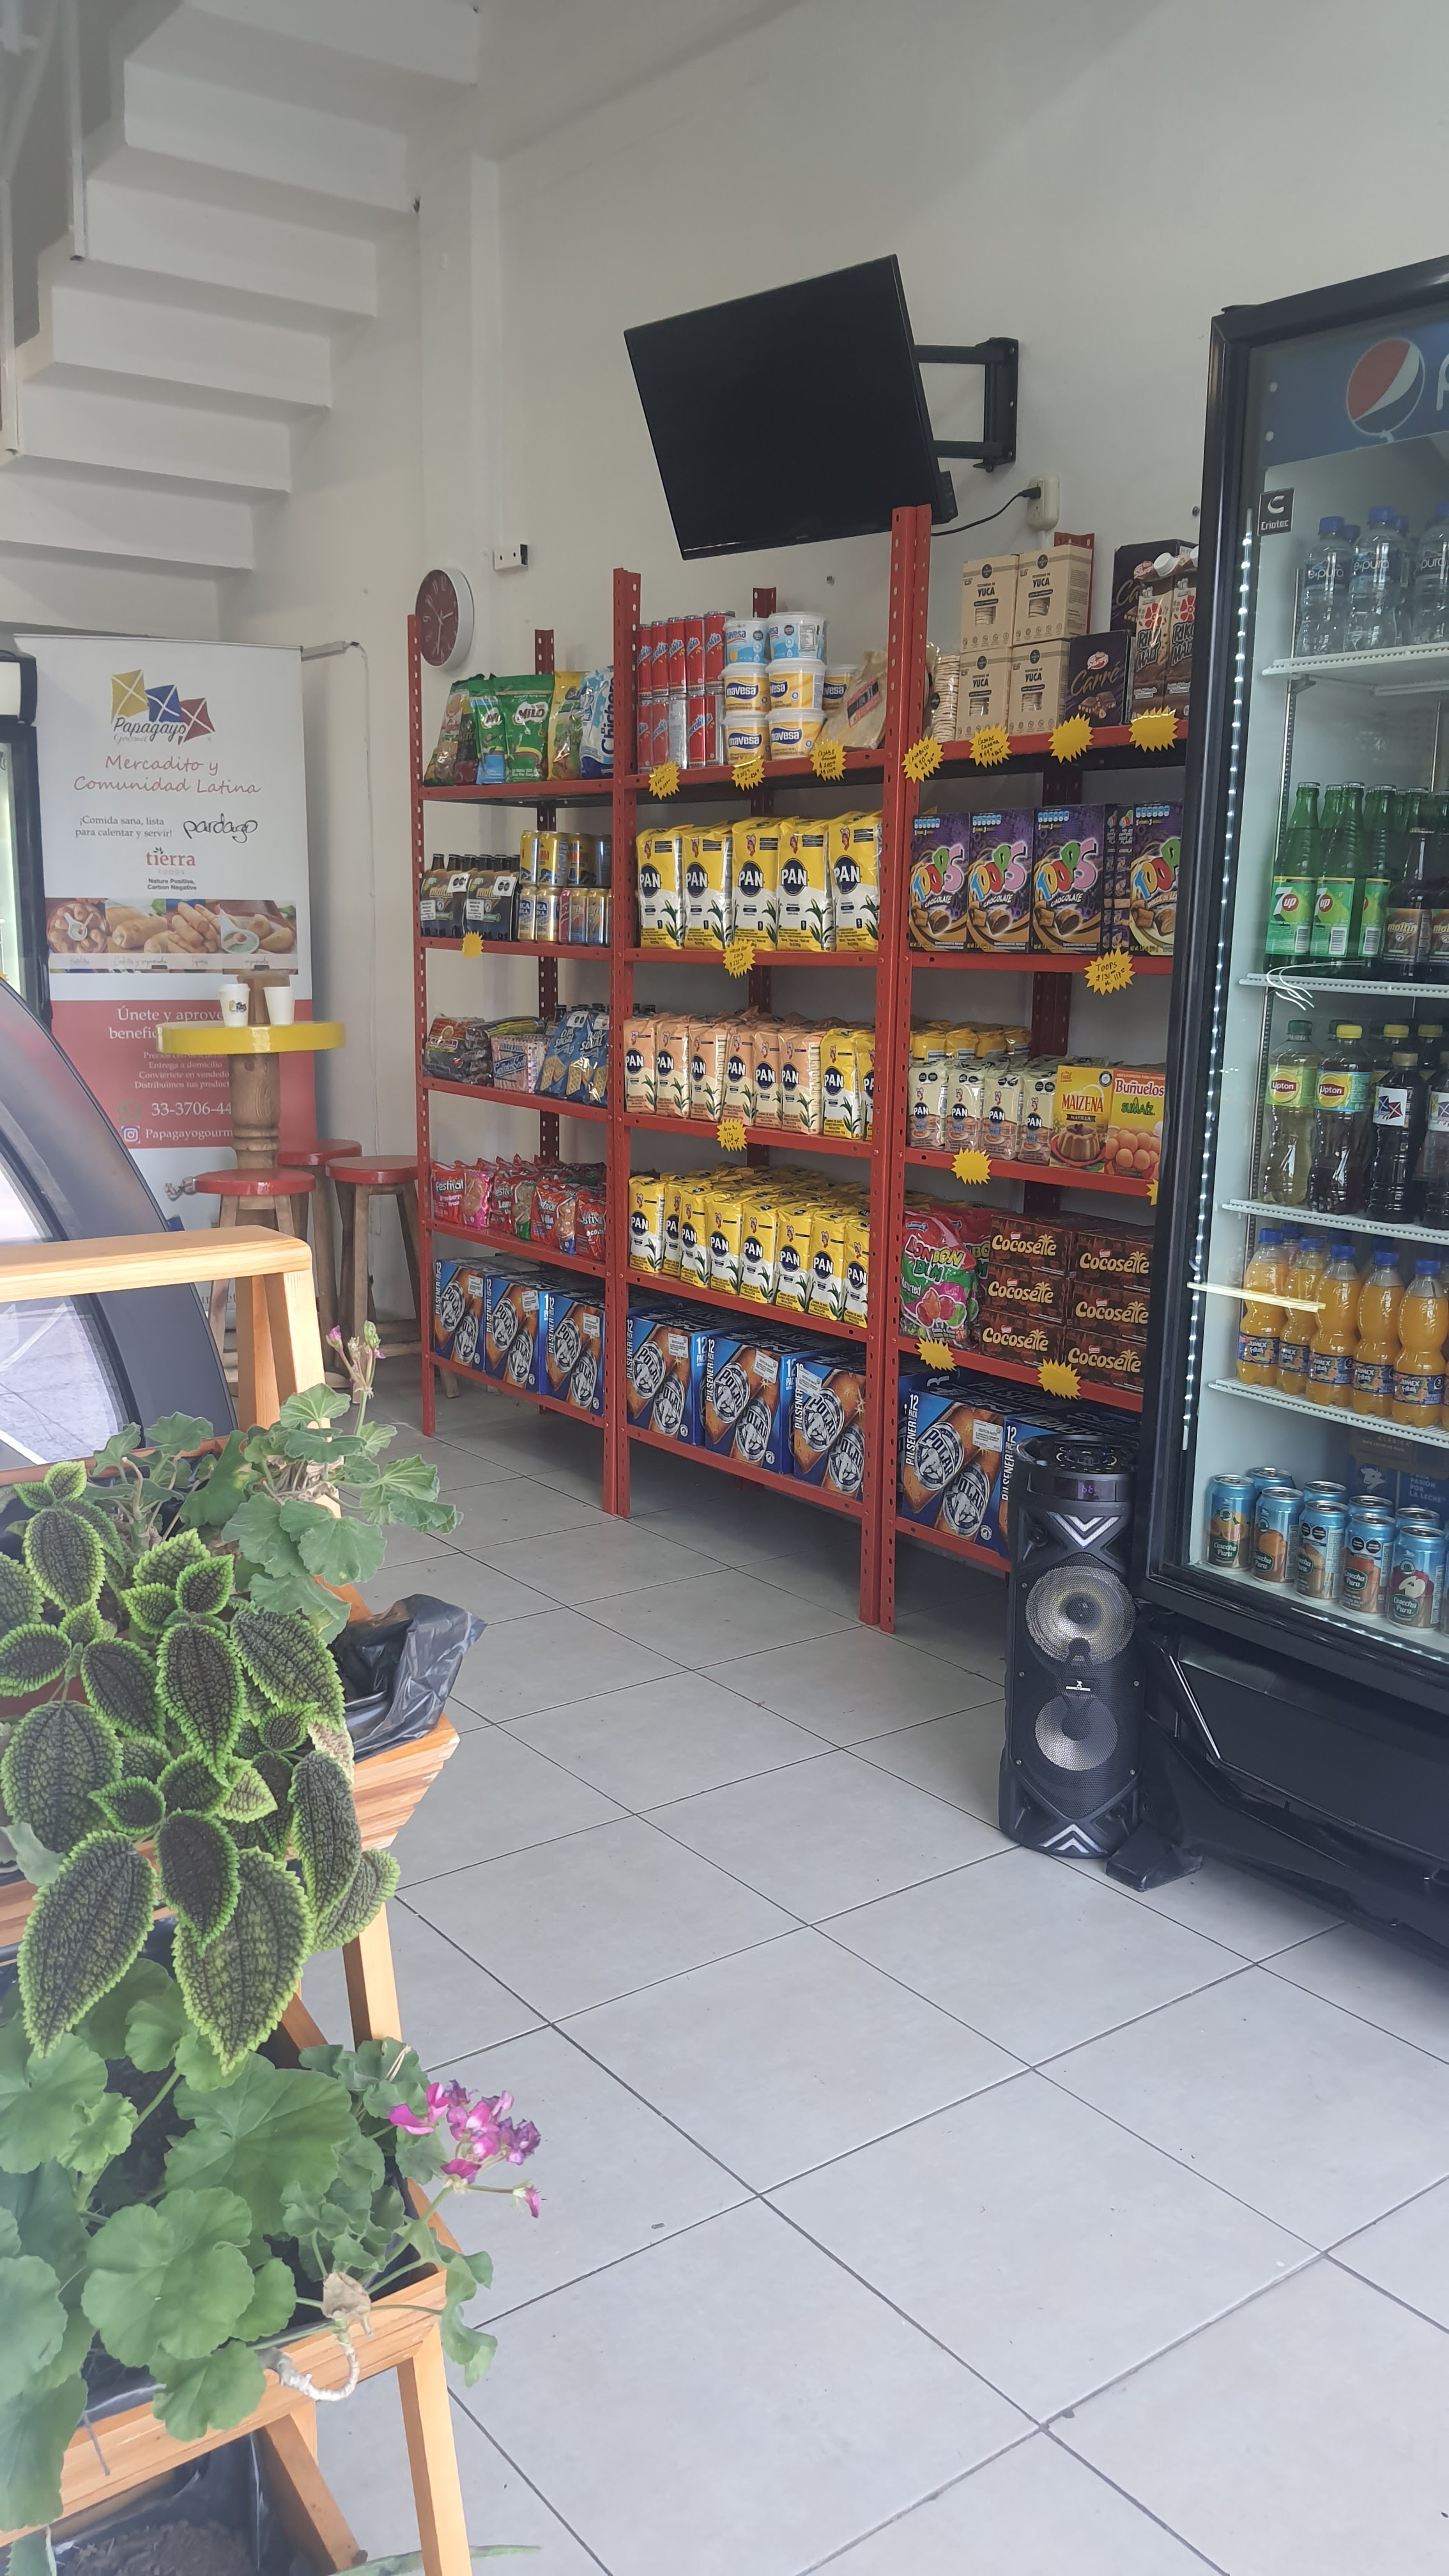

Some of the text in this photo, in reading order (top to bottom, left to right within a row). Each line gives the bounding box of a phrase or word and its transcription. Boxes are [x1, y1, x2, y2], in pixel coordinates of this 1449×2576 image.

[1032, 578, 1050, 588] YUCA
[977, 586, 995, 597] YUCA
[972, 678, 989, 688] YUCA
[1025, 673, 1042, 682] YUCA
[1070, 661, 1121, 696] Carré
[726, 686, 756, 696] mavesa
[113, 717, 187, 742] Papagayo
[729, 736, 760, 746] mavesa
[105, 755, 219, 776] Mercadito y
[73, 776, 262, 794] Comunidad Latina
[80, 815, 118, 826] ¡Comida
[146, 817, 165, 825] lista
[183, 813, 258, 843] pardago
[75, 829, 96, 839] para
[98, 829, 133, 837] calentar
[135, 831, 141, 839] y
[146, 850, 195, 866] tierra
[781, 868, 808, 885] PAN
[834, 866, 860, 884] PAN
[912, 844, 963, 901] TOOPS
[970, 841, 1026, 901] TOOPS
[1036, 838, 1098, 900] TOOPS
[639, 873, 661, 889] PAN
[686, 872, 708, 888] PAN
[738, 871, 763, 888] PAN
[924, 895, 953, 908] CHOCOLATE
[983, 894, 1013, 908] CHOCOLATE
[1050, 893, 1084, 907] CHOCOLATE
[1095, 962, 1117, 972] TOOPS
[117, 1005, 160, 1021] Únete
[162, 1013, 172, 1022] y
[149, 1062, 179, 1070] Entrega
[625, 1055, 645, 1068] PAN
[657, 1056, 674, 1070] PAN
[691, 1061, 706, 1075] PAN
[727, 1061, 746, 1077] PAN
[755, 1068, 775, 1083] PAN
[781, 1070, 799, 1084] PAN
[824, 1073, 843, 1088] PAN
[1116, 1079, 1165, 1096] Buñuelos
[1273, 1081, 1294, 1091] Lipton
[1319, 1085, 1342, 1095] Lipton
[1062, 1094, 1103, 1113] MAIZENA
[1121, 1101, 1154, 1116] SUMAÍZ
[914, 1107, 929, 1116] PAN
[951, 1107, 967, 1117] PAN
[989, 1110, 1005, 1121] PAN
[1026, 1117, 1042, 1128] PAN
[436, 1179, 463, 1192] Festival
[631, 1216, 648, 1230] PAN
[681, 1227, 697, 1243] PAN
[710, 1237, 729, 1252] PAN
[744, 1242, 763, 1258] PAN
[992, 1234, 1057, 1256] Cocosette
[780, 1251, 800, 1267] PAN
[813, 1257, 833, 1274] PAN
[1079, 1250, 1150, 1274] Cocosette
[847, 1268, 867, 1284] PAN
[988, 1281, 1054, 1304] Cocosette
[1075, 1300, 1149, 1324] Cocosette
[982, 1328, 1048, 1351] Cocosette
[1068, 1347, 1142, 1373] Cocosette
[707, 1361, 715, 1402] PILSENER
[795, 1388, 804, 1430] PILSENER
[910, 1394, 919, 1411] 12
[1007, 1425, 1017, 1444] 12
[906, 1419, 917, 1466] PILSENER
[921, 1429, 954, 1478] POLAR
[1420, 1492, 1442, 1503] LECHE
[1217, 1549, 1233, 1557] Pura
[1344, 1569, 1365, 1582] Cosecha
[1346, 1578, 1361, 1587] Pura
[1393, 1596, 1417, 1608] Cosecha
[1395, 1604, 1413, 1614] Pura
